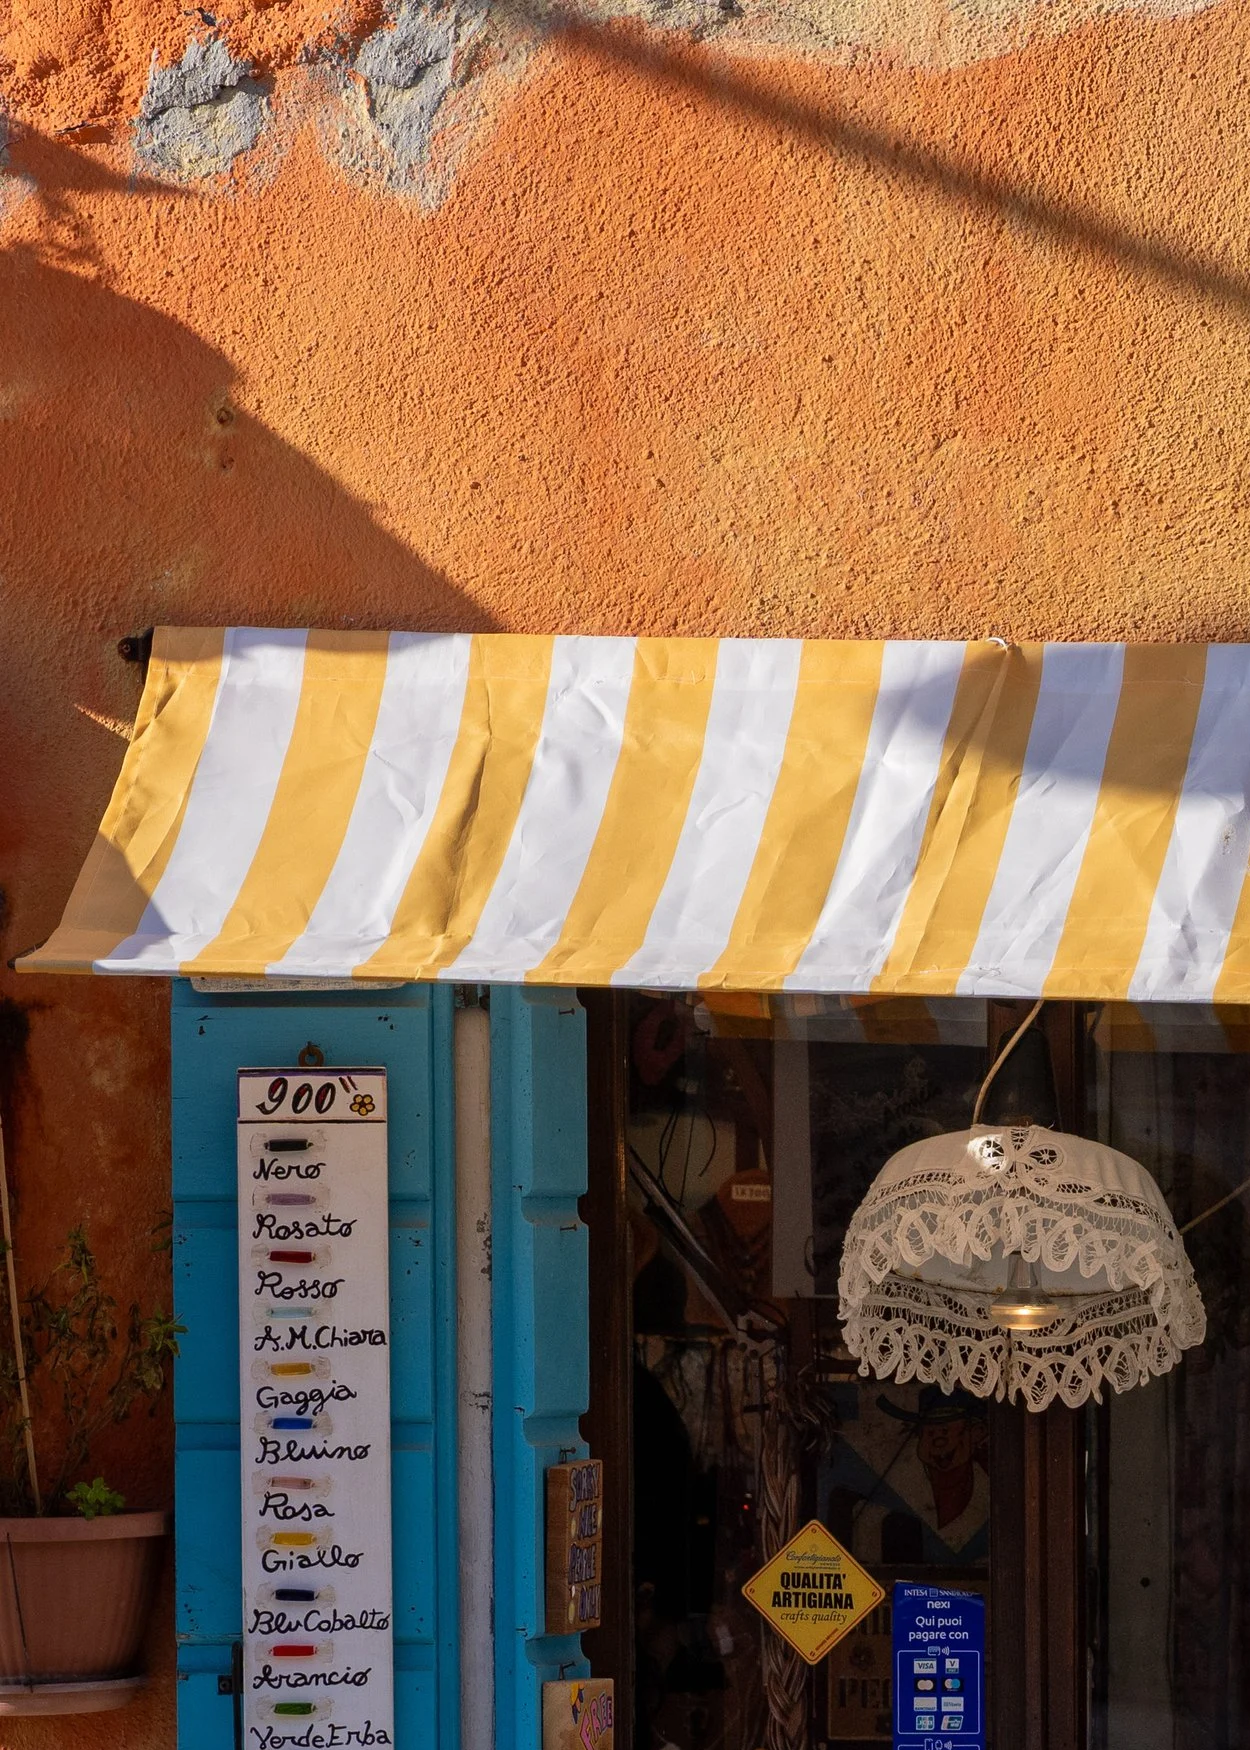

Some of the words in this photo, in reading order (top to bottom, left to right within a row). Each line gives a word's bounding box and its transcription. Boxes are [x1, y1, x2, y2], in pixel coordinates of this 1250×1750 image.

[253, 1158, 326, 1180] Nero
[253, 1214, 358, 1240] Rosato
[255, 1271, 346, 1299] Rosso
[256, 1380, 357, 1416] Gaggia
[256, 1435, 371, 1464] Bluino
[259, 1491, 335, 1521] Rosa
[261, 1544, 364, 1573] Giallo
[771, 1590, 854, 1610] ARTIGIANA
[904, 1589, 928, 1597] INTESA
[927, 1600, 950, 1609] nexi
[780, 1610, 809, 1623] crafts
[811, 1611, 848, 1625] quality
[915, 1616, 936, 1628] Qui
[937, 1616, 962, 1629] puoi
[909, 1631, 947, 1642] pagare
[948, 1631, 969, 1640] con
[253, 1664, 372, 1690] Arancio
[917, 1662, 934, 1670] VISA
[250, 1726, 325, 1750] Verde
[325, 1720, 392, 1750] Erba
